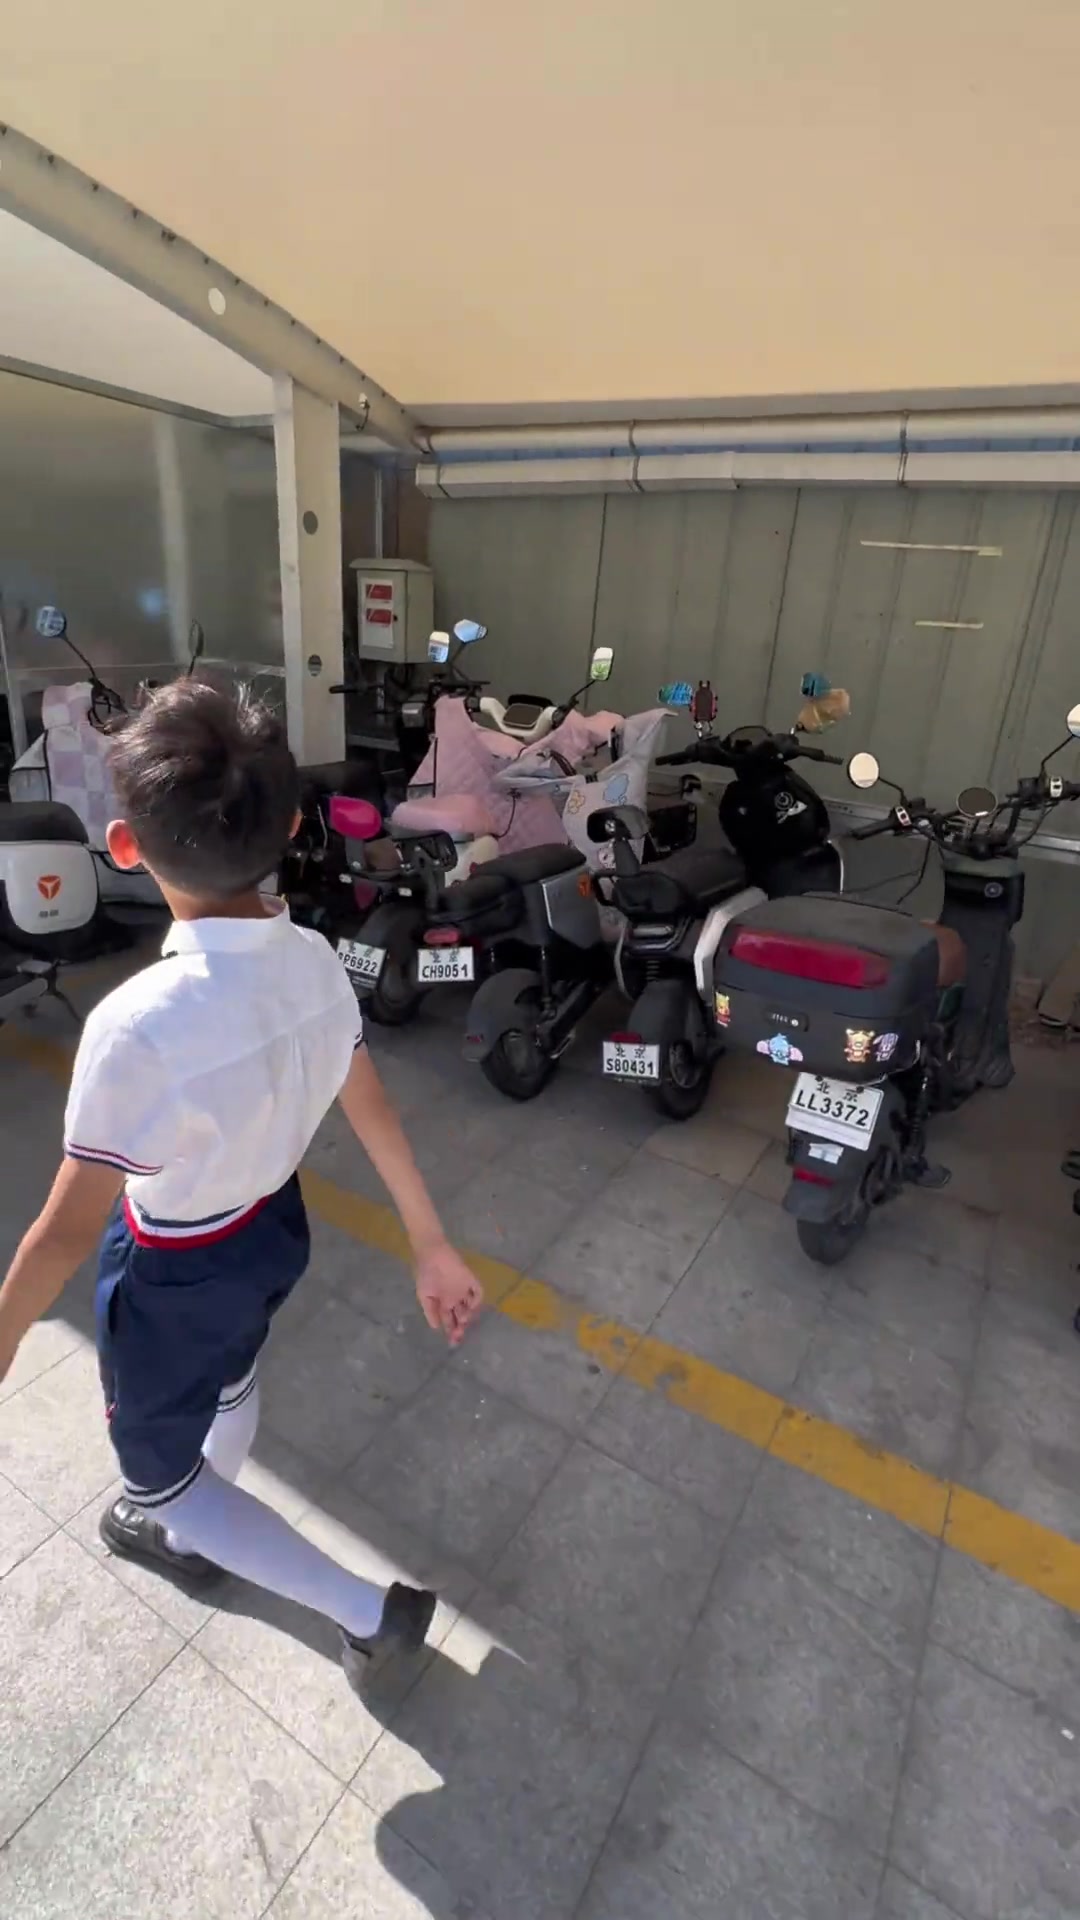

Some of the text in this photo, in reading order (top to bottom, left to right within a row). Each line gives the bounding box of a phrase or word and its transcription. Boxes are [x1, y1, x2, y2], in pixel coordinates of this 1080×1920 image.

[422, 963, 468, 978] CH9051
[606, 1058, 653, 1075] S80431
[795, 1090, 869, 1126] LL3372
